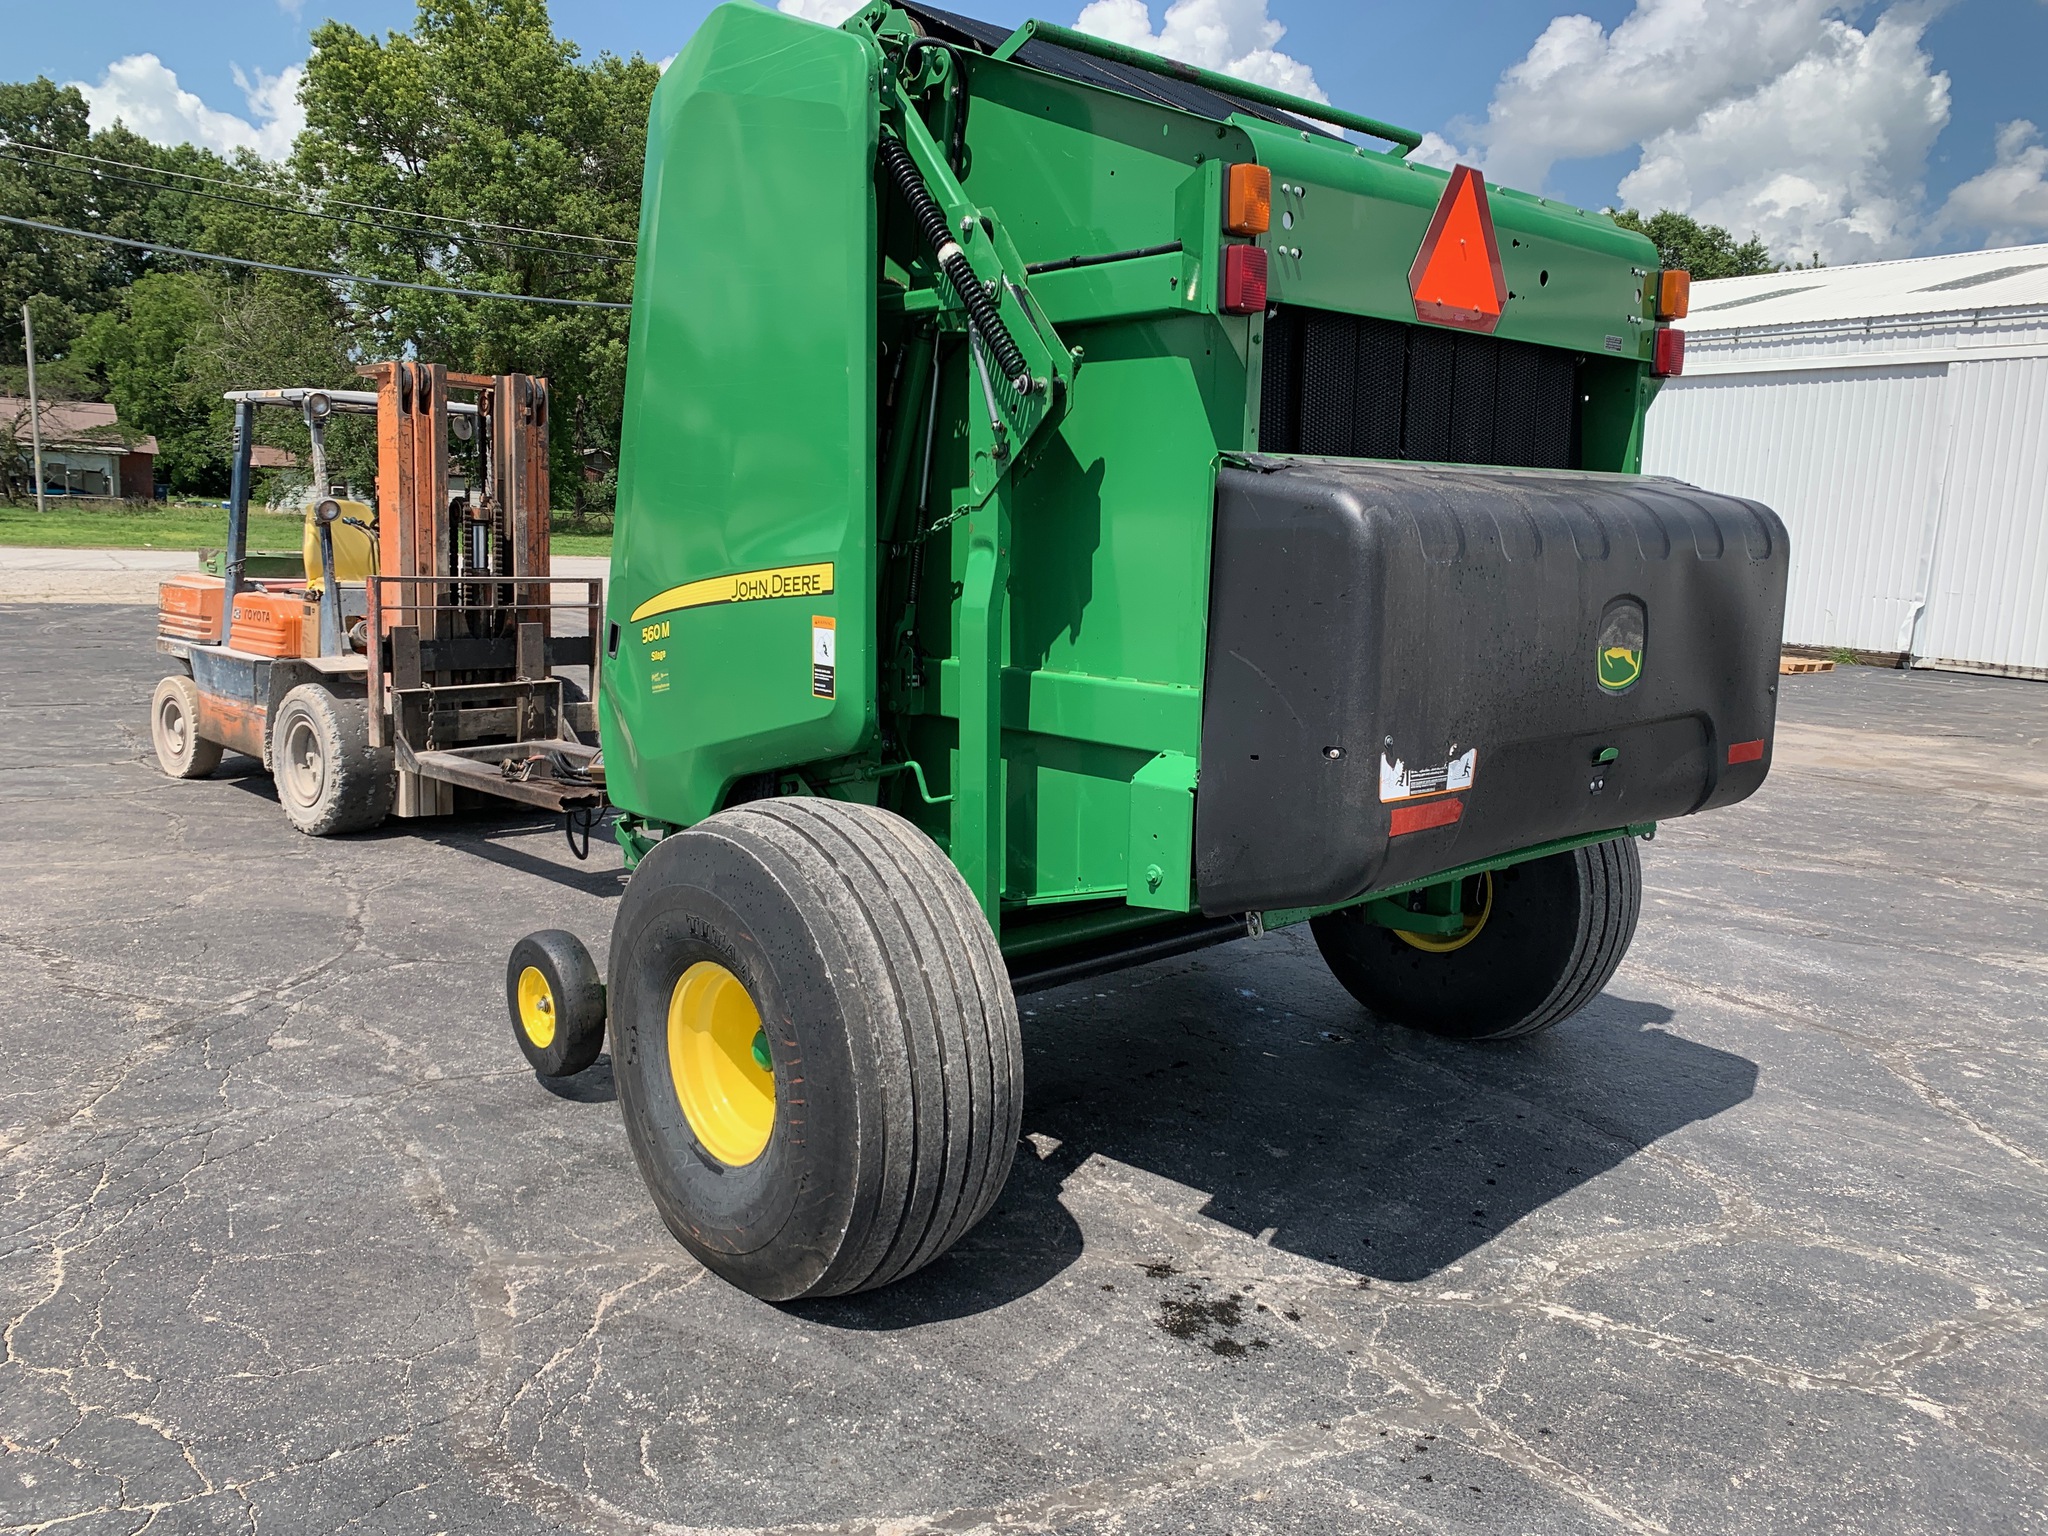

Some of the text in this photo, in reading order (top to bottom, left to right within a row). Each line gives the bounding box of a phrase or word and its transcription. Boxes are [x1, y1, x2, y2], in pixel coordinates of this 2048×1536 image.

[731, 574, 821, 599] JOHN DEERE
[244, 608, 271, 623] TOYOTA
